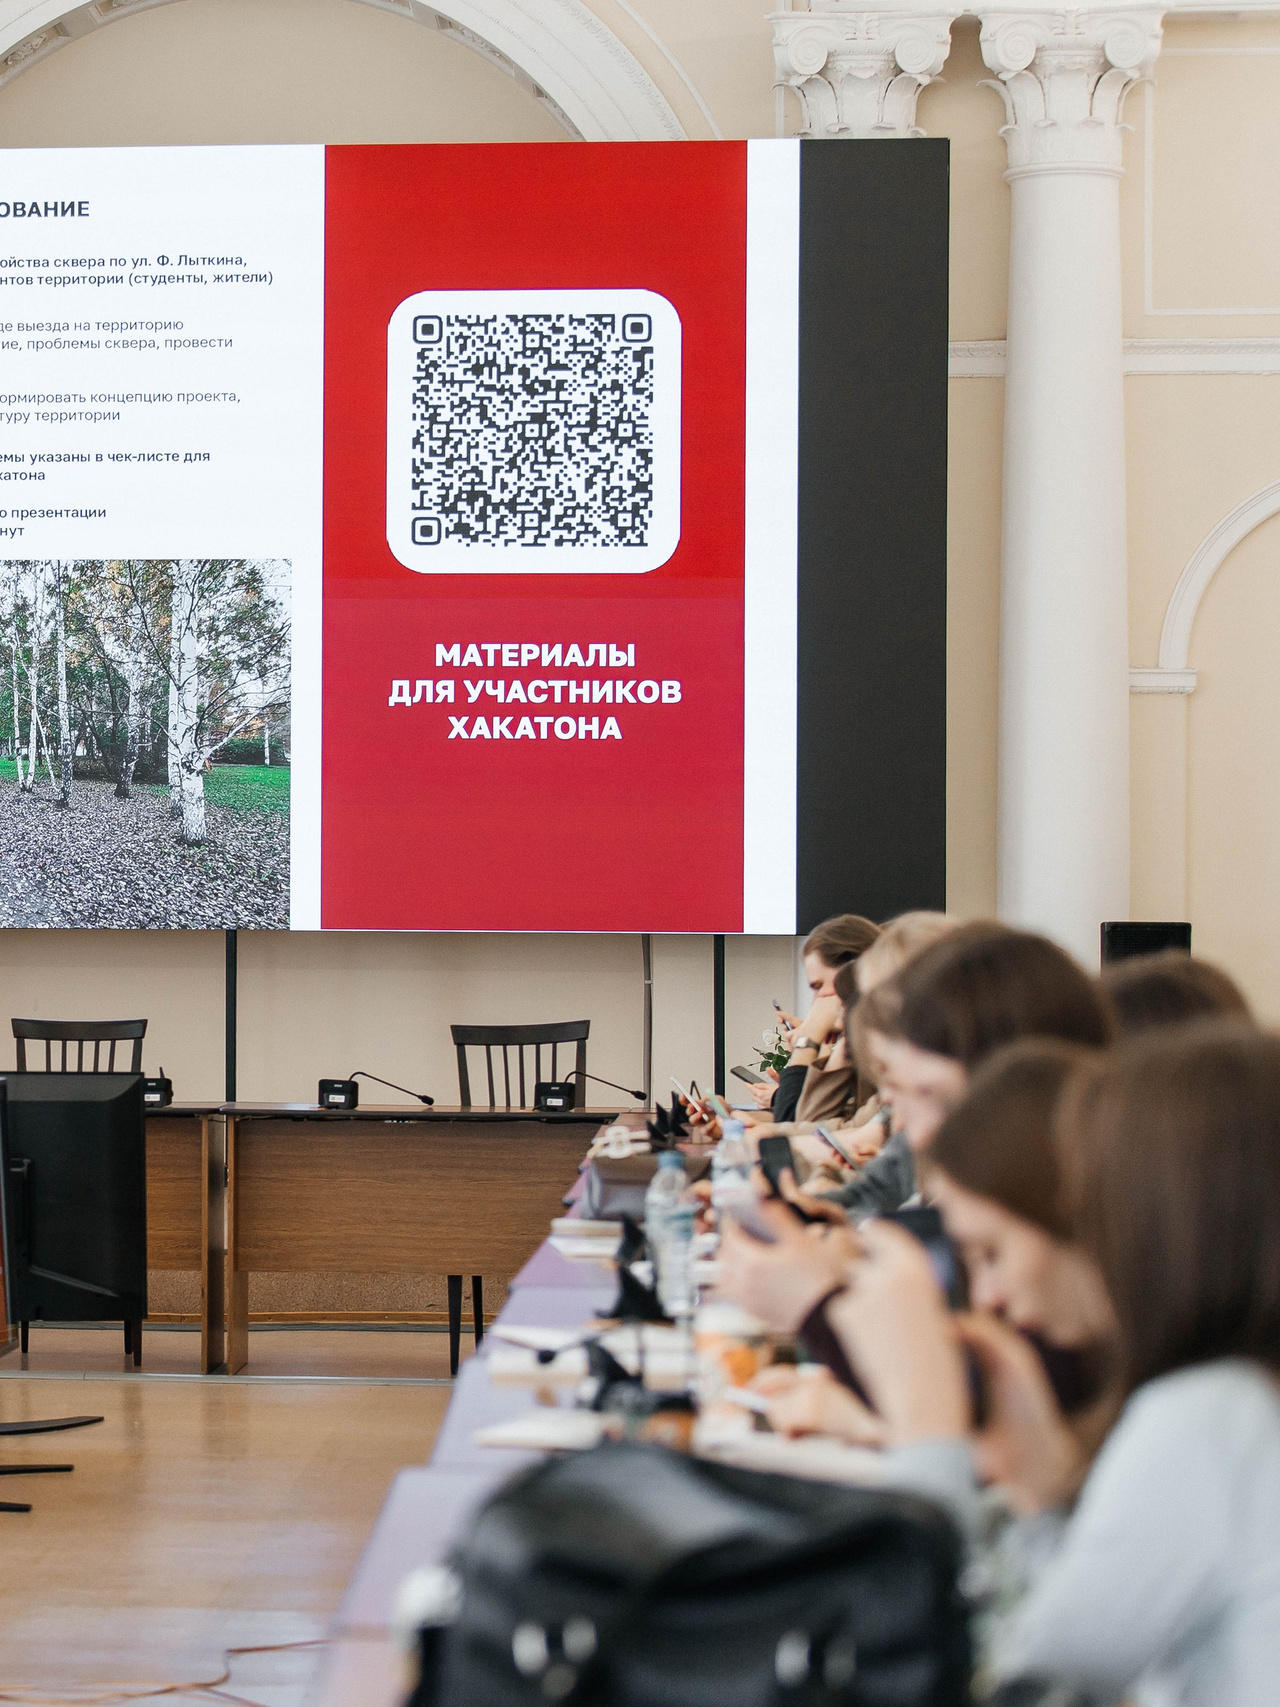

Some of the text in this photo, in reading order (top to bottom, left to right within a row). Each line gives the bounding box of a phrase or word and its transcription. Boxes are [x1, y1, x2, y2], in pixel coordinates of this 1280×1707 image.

[53, 257, 105, 270] сквера
[109, 257, 127, 267] по
[130, 257, 151, 270] ул.
[156, 254, 173, 267] Ф.
[177, 254, 247, 268] Лыткина,
[36, 274, 124, 288] территории
[128, 272, 207, 287] (студенты,
[212, 270, 273, 286] жители)
[16, 321, 70, 333] выезда
[73, 321, 91, 331] на
[94, 320, 184, 334] территорию
[26, 337, 100, 352] проблемы
[104, 338, 160, 351] сквера,
[164, 338, 233, 351] провести
[90, 392, 173, 404] концепцию
[176, 391, 241, 405] проекта,
[33, 410, 120, 424] территории
[29, 452, 90, 466] указаны
[95, 453, 103, 462] в
[107, 452, 180, 462] чек-листе
[183, 452, 210, 464] для
[11, 508, 106, 521] презентации
[434, 643, 636, 667] МАТЕРИАЛЫ
[388, 679, 683, 707] ДЛЯ УЧАСТНИКОВ
[447, 716, 623, 740] ХАКАТОНА
